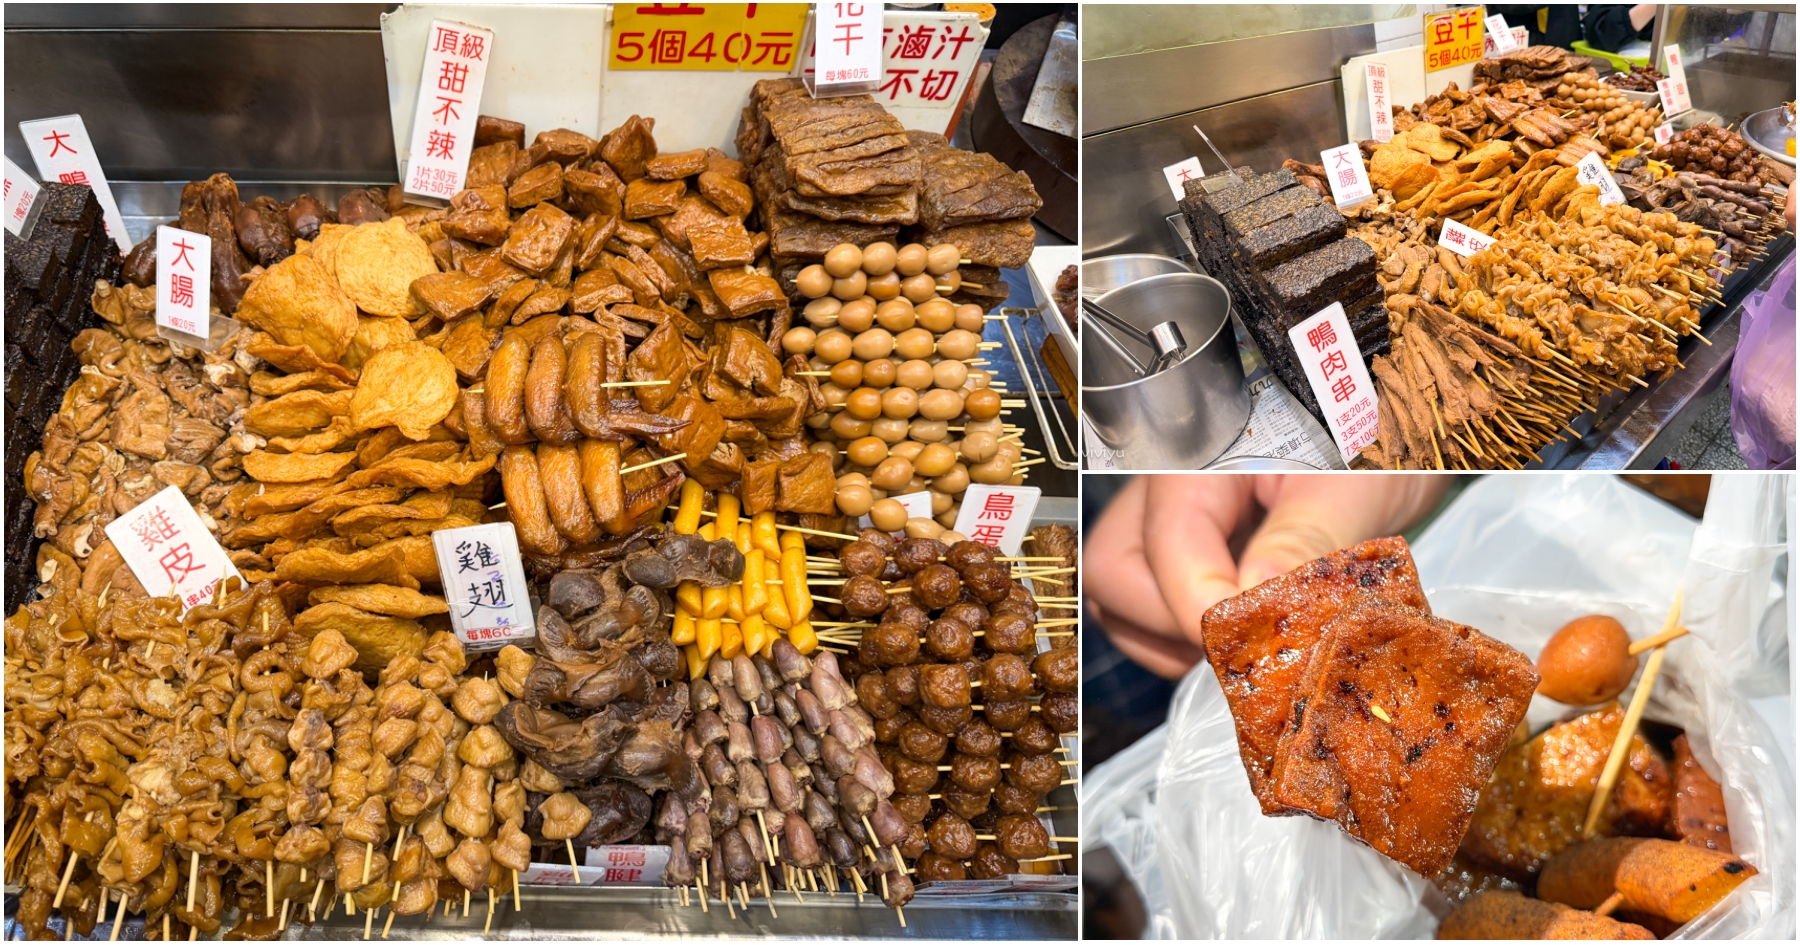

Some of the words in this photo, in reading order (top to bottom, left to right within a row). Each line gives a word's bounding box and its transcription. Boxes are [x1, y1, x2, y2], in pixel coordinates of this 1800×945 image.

[433, 27, 485, 61] 頂級
[1433, 11, 1477, 45] 豆干
[615, 28, 794, 66] 5個40元
[1429, 43, 1483, 68] 5個40元
[825, 67, 869, 82] 每塊60元
[1368, 65, 1386, 78] 頂級
[425, 60, 470, 160] 甜不辣
[1373, 79, 1388, 124] 甜不辣
[415, 165, 458, 185] 1片30元
[1332, 150, 1358, 189] 大腸
[412, 177, 456, 198] 2片50元
[170, 238, 195, 309] 大腸
[168, 315, 197, 333] 1條20元
[1306, 320, 1357, 403] 鴨肉串
[1335, 396, 1372, 427] 1支20元
[1340, 410, 1378, 442] 3支50元
[970, 492, 1015, 548] 鳥蛋
[129, 504, 207, 584] 雞皮
[455, 540, 514, 619] 雞翅
[466, 626, 525, 640] 每塊60
